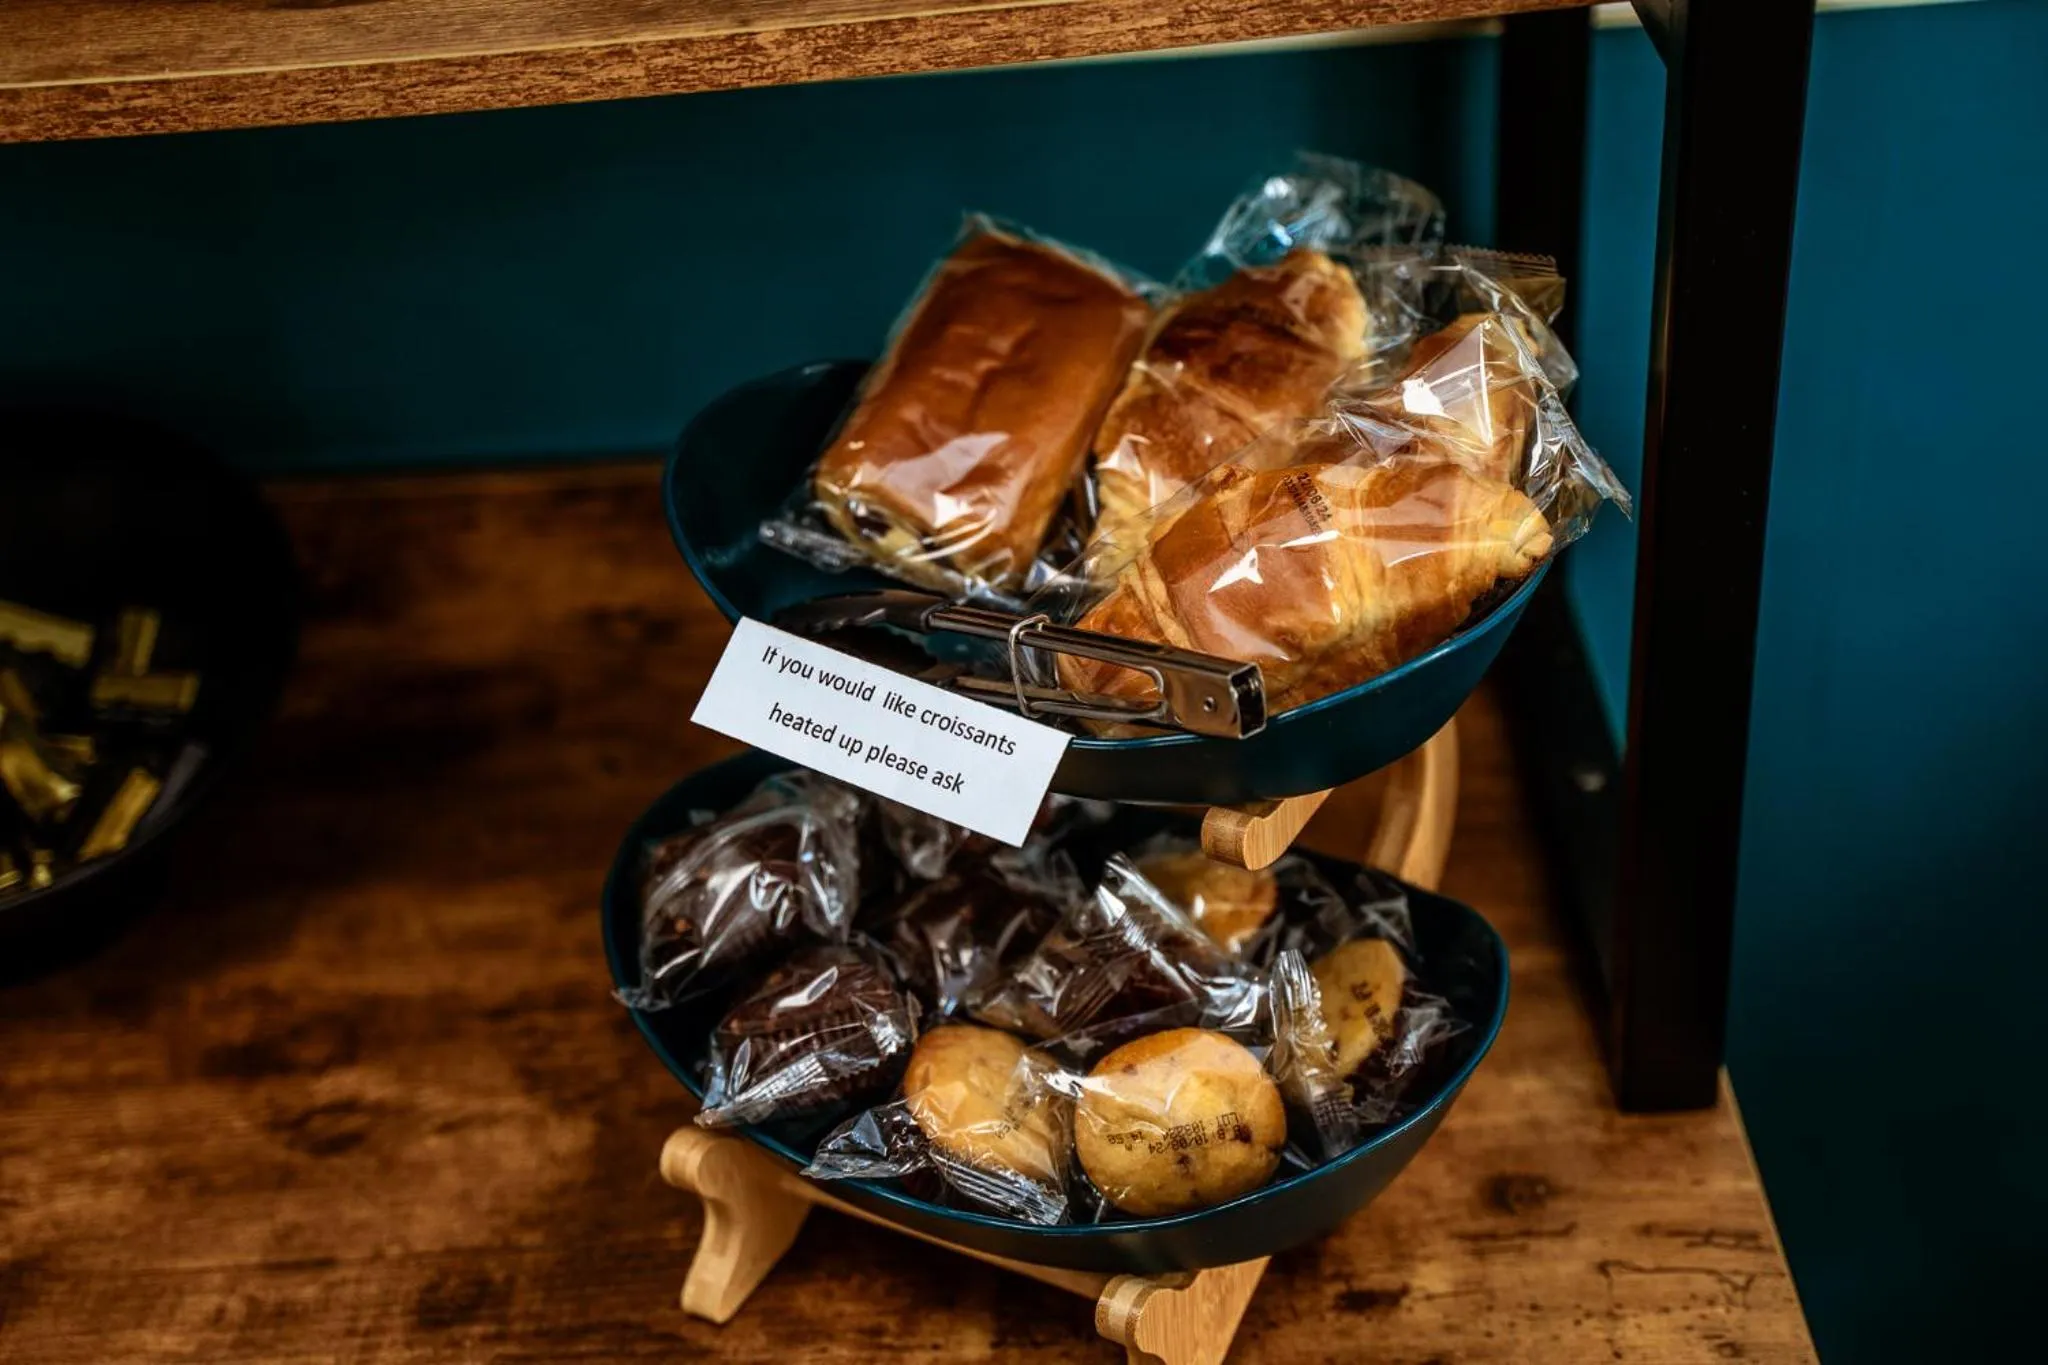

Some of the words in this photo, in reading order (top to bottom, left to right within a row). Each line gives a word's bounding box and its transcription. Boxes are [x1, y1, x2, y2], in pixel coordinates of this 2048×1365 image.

[762, 645, 780, 665] If
[778, 655, 815, 680] you
[818, 669, 877, 702] would
[882, 691, 917, 719] like
[920, 709, 1017, 756] croissants
[768, 701, 838, 744] heated
[838, 734, 864, 757] up
[864, 744, 929, 780] please
[931, 770, 965, 795] ask
